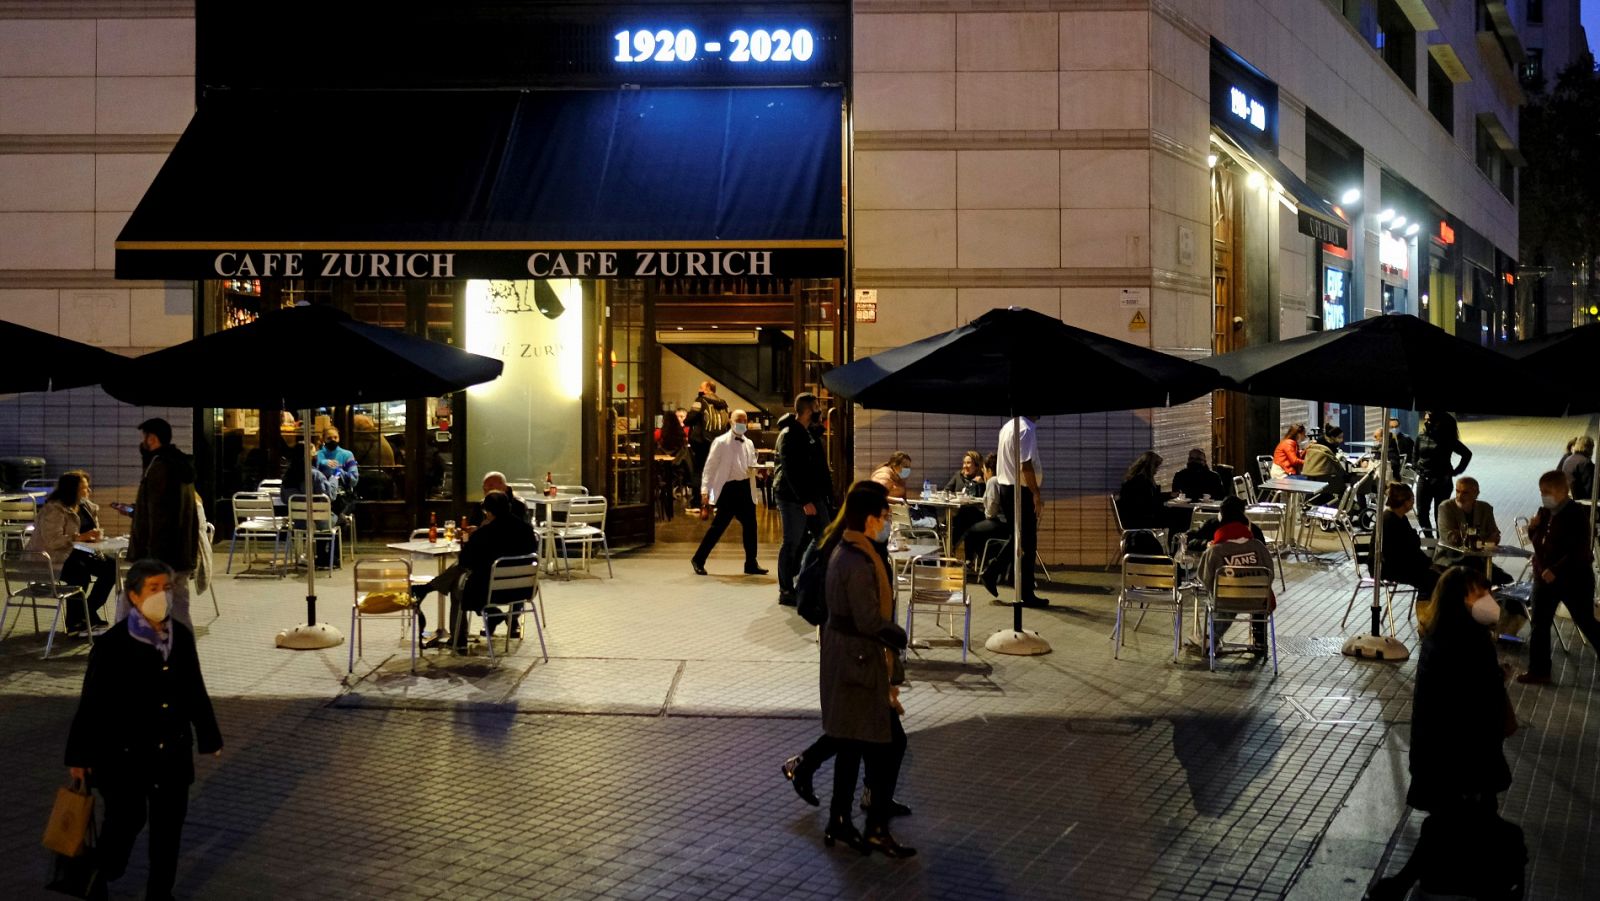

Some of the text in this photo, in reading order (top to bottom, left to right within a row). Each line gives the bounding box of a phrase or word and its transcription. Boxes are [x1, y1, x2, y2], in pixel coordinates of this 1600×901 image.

[614, 29, 813, 62] 1920 - 2020
[214, 252, 456, 277] CAFE ZURICH
[527, 251, 773, 276] CAFE ZURICH
[1224, 552, 1257, 566] VANS
